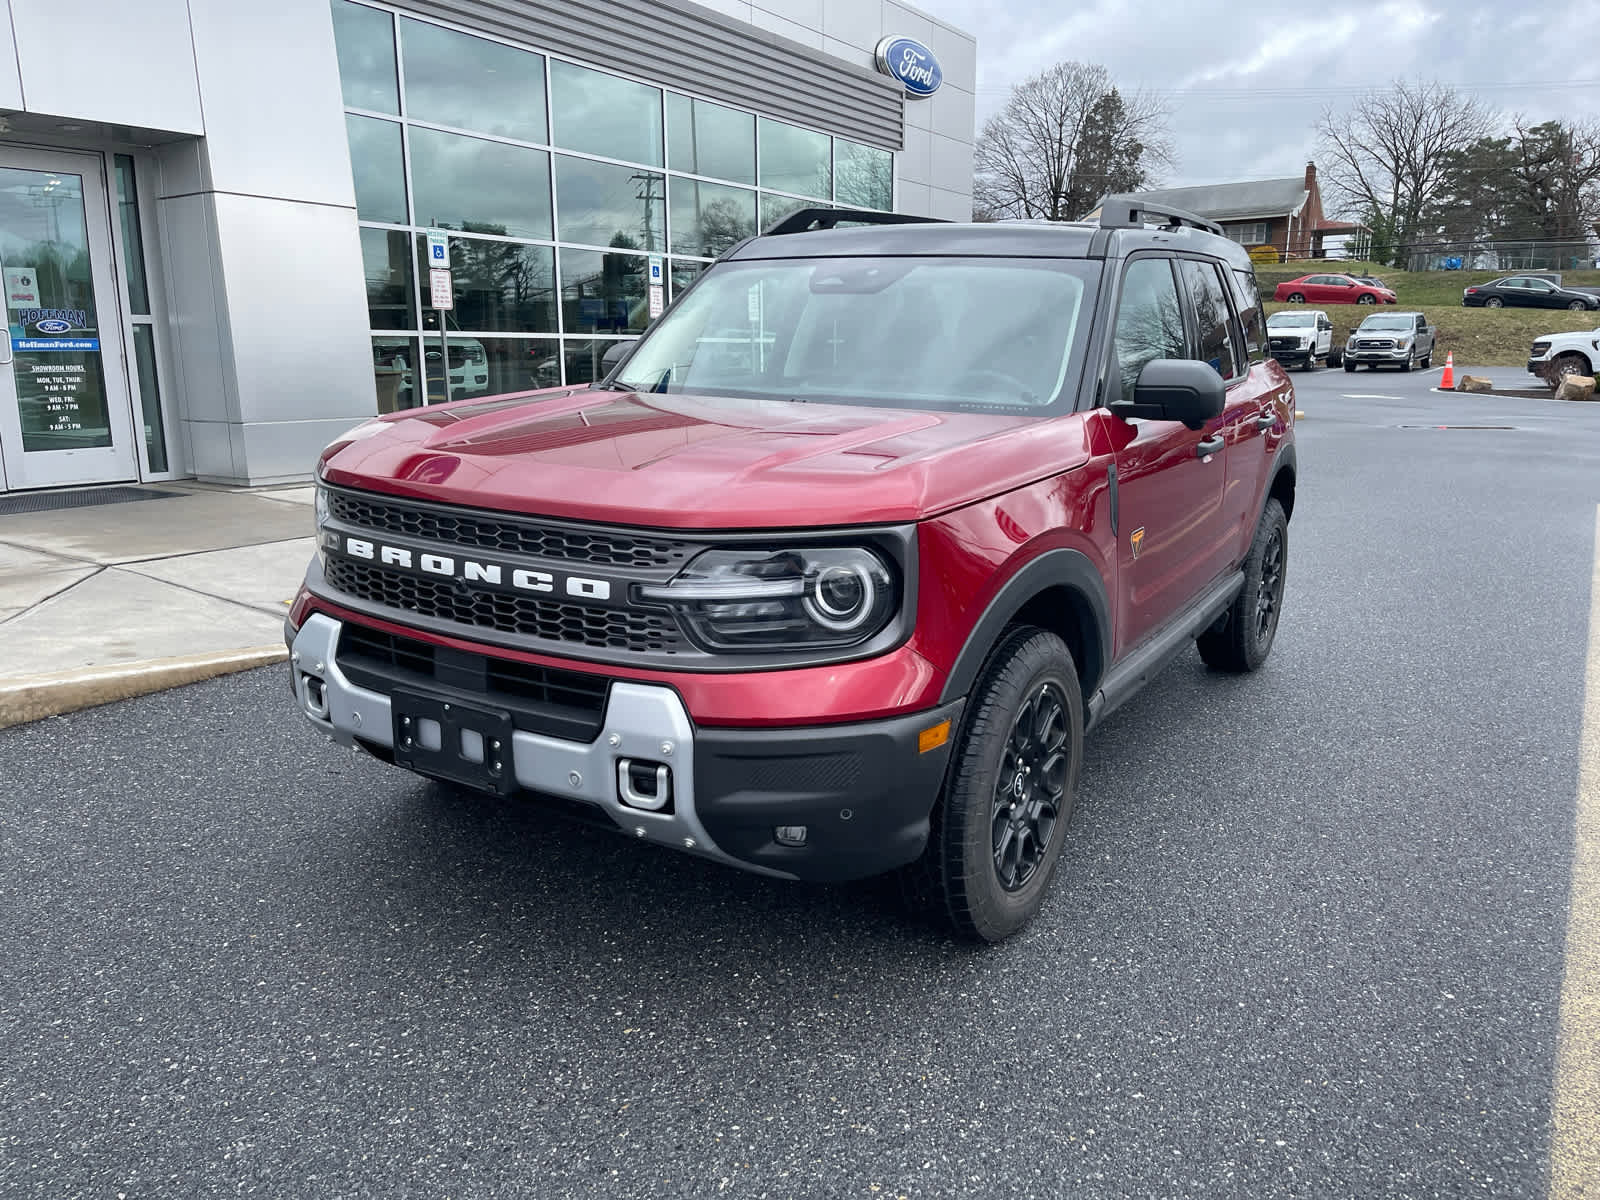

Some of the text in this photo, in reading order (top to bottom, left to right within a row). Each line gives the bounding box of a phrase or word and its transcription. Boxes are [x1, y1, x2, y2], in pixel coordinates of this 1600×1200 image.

[900, 48, 934, 86] Ford
[19, 309, 87, 328] HOFFMAN
[346, 538, 610, 600] BRONCO
